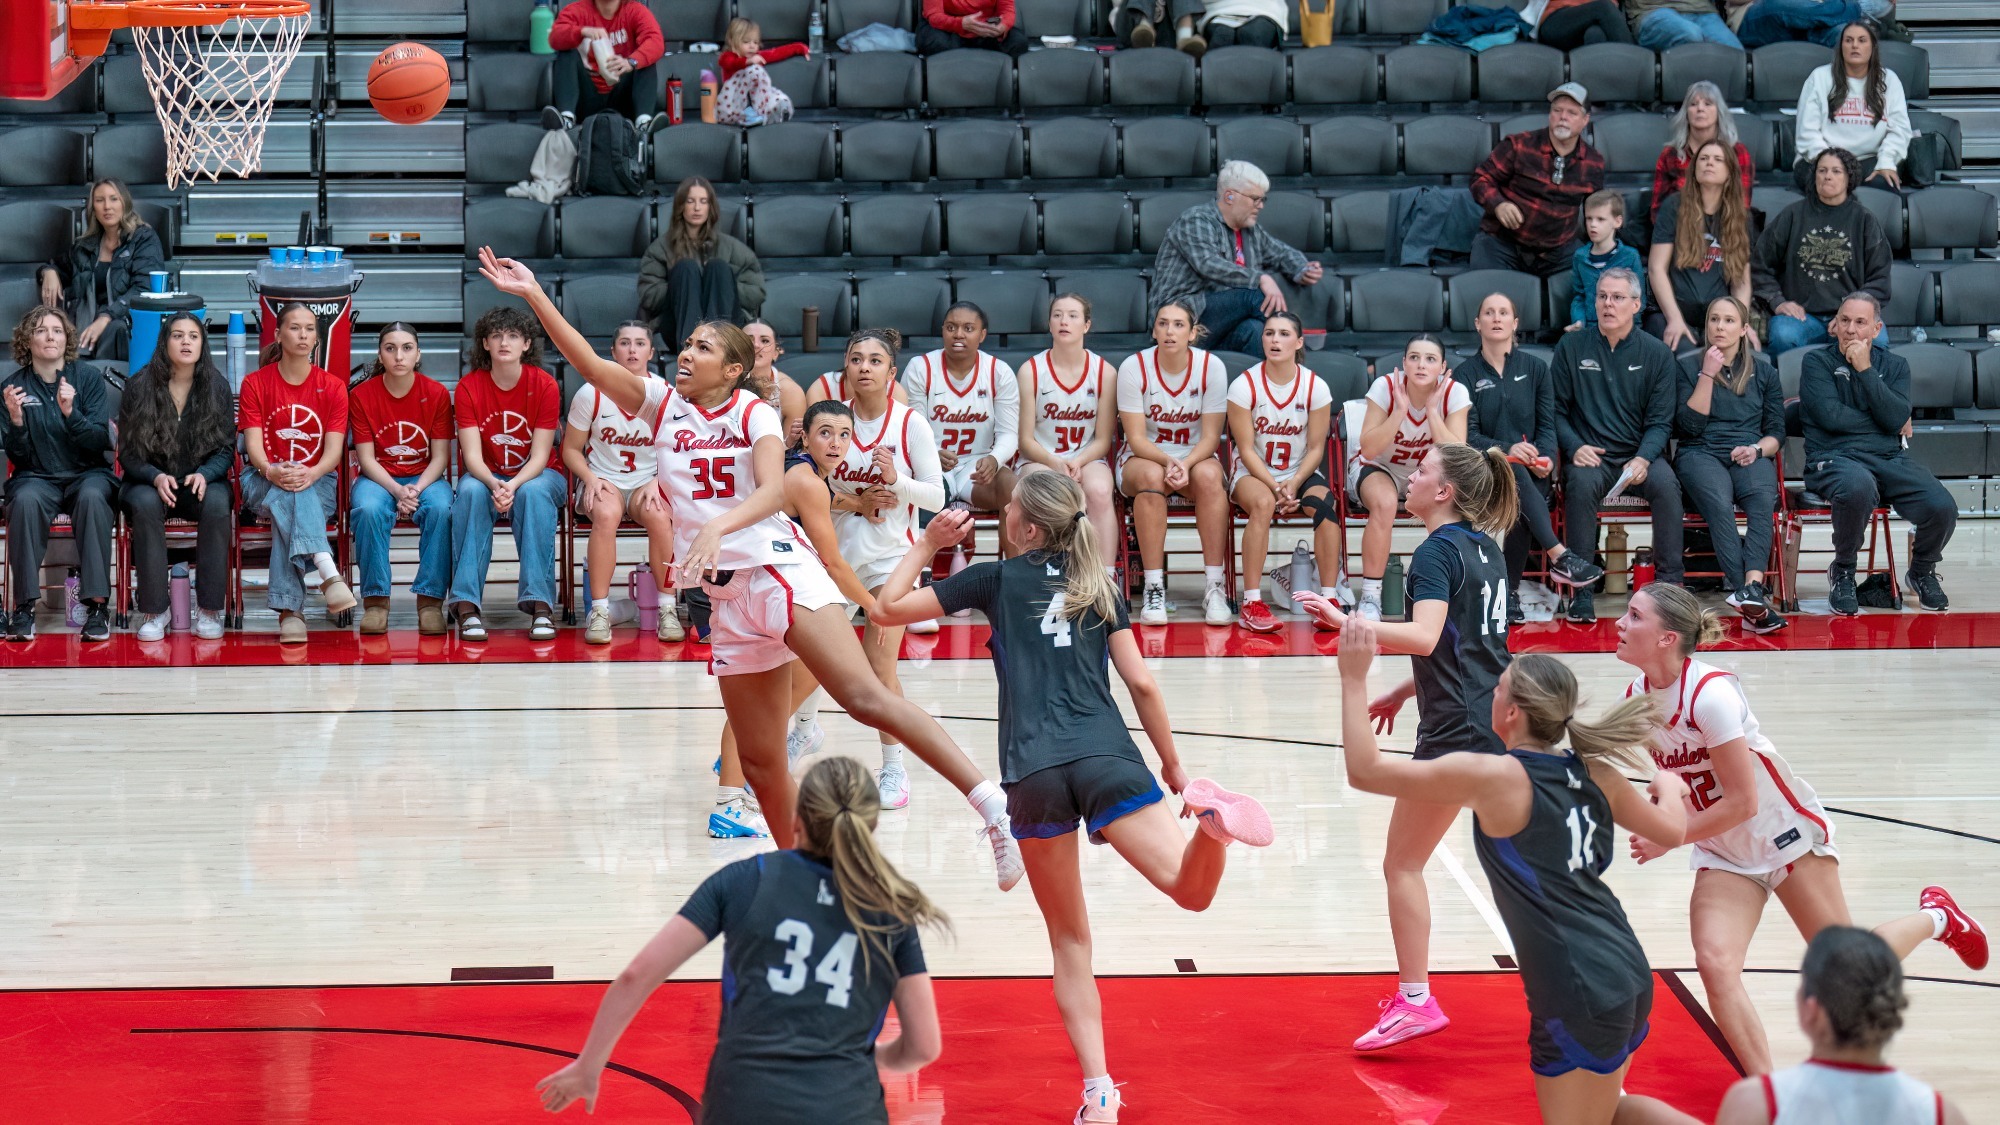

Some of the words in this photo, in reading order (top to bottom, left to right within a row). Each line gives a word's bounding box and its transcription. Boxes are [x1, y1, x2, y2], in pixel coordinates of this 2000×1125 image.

[277, 302, 339, 315] BRMOR
[930, 404, 989, 423] Raiders
[1043, 402, 1096, 421] Raiders
[1145, 404, 1201, 423] Raiders
[1054, 426, 1085, 453] 34
[1254, 416, 1303, 436] Raiders
[941, 428, 976, 455] 22
[620, 450, 637, 473] 3
[1265, 441, 1291, 471] 13
[1390, 448, 1429, 467] 24
[690, 456, 735, 501] 35
[832, 459, 888, 485] Raider
[1040, 592, 1072, 648] 4
[1480, 578, 1508, 636] 14
[1648, 741, 1711, 770] Raider
[1681, 769, 1723, 812] 12
[766, 918, 859, 1009] 34
